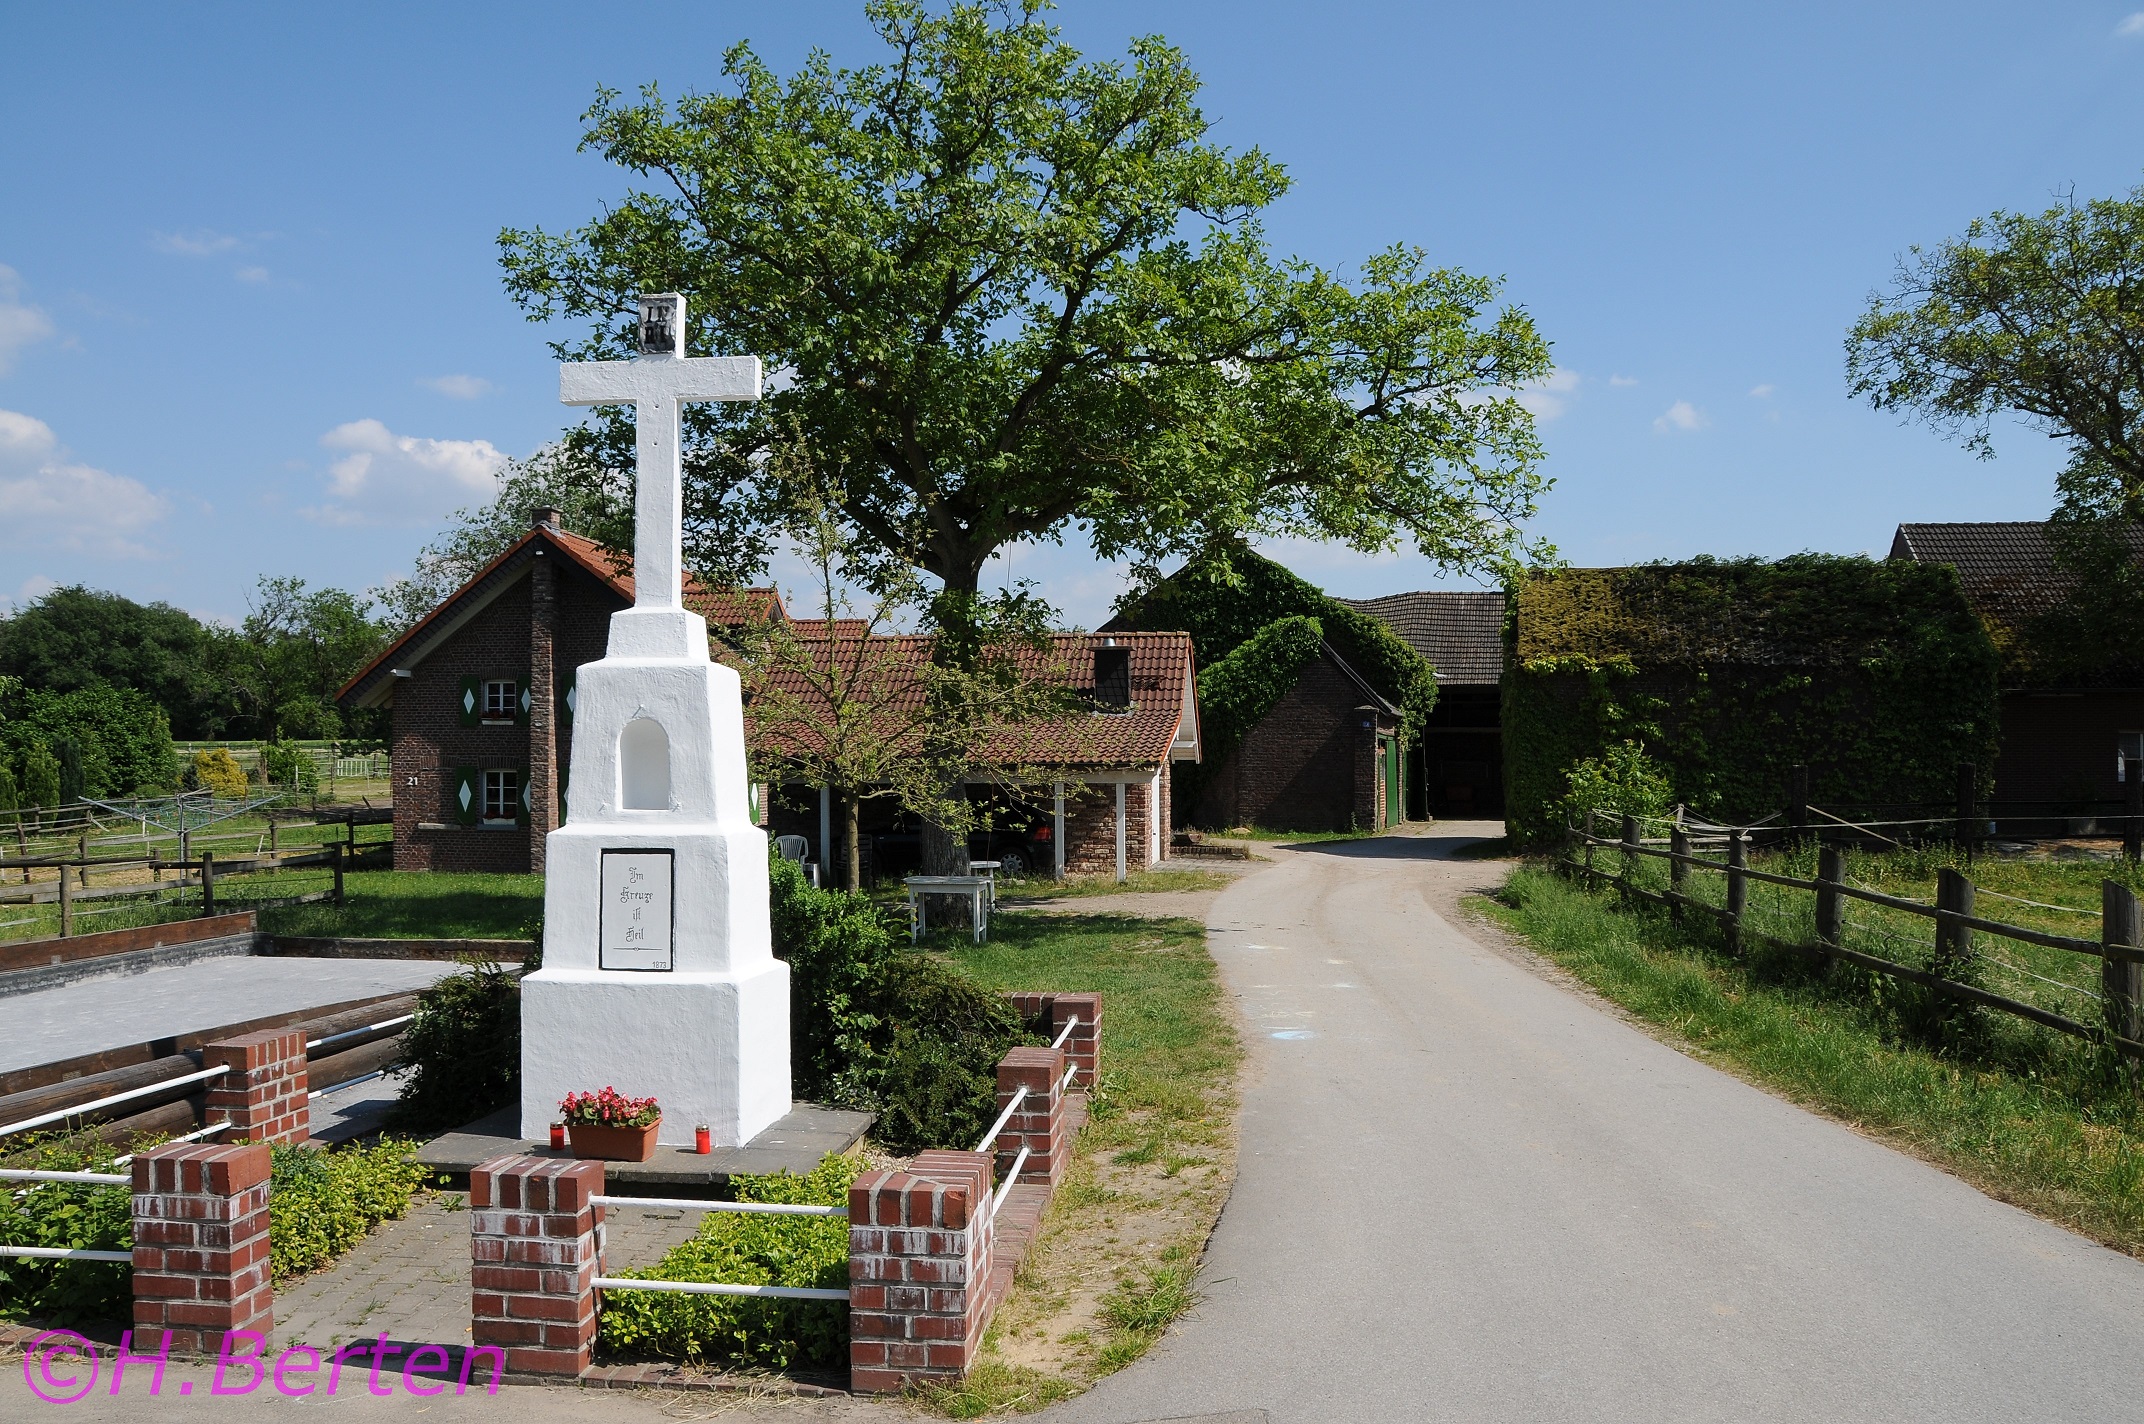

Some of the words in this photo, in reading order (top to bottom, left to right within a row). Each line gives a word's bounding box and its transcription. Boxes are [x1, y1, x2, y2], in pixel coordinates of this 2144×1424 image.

[406, 776, 418, 786] 21
[629, 866, 644, 884] Im
[620, 886, 653, 904] Kreuze
[625, 926, 644, 942] Heil
[652, 961, 667, 969] 1873
